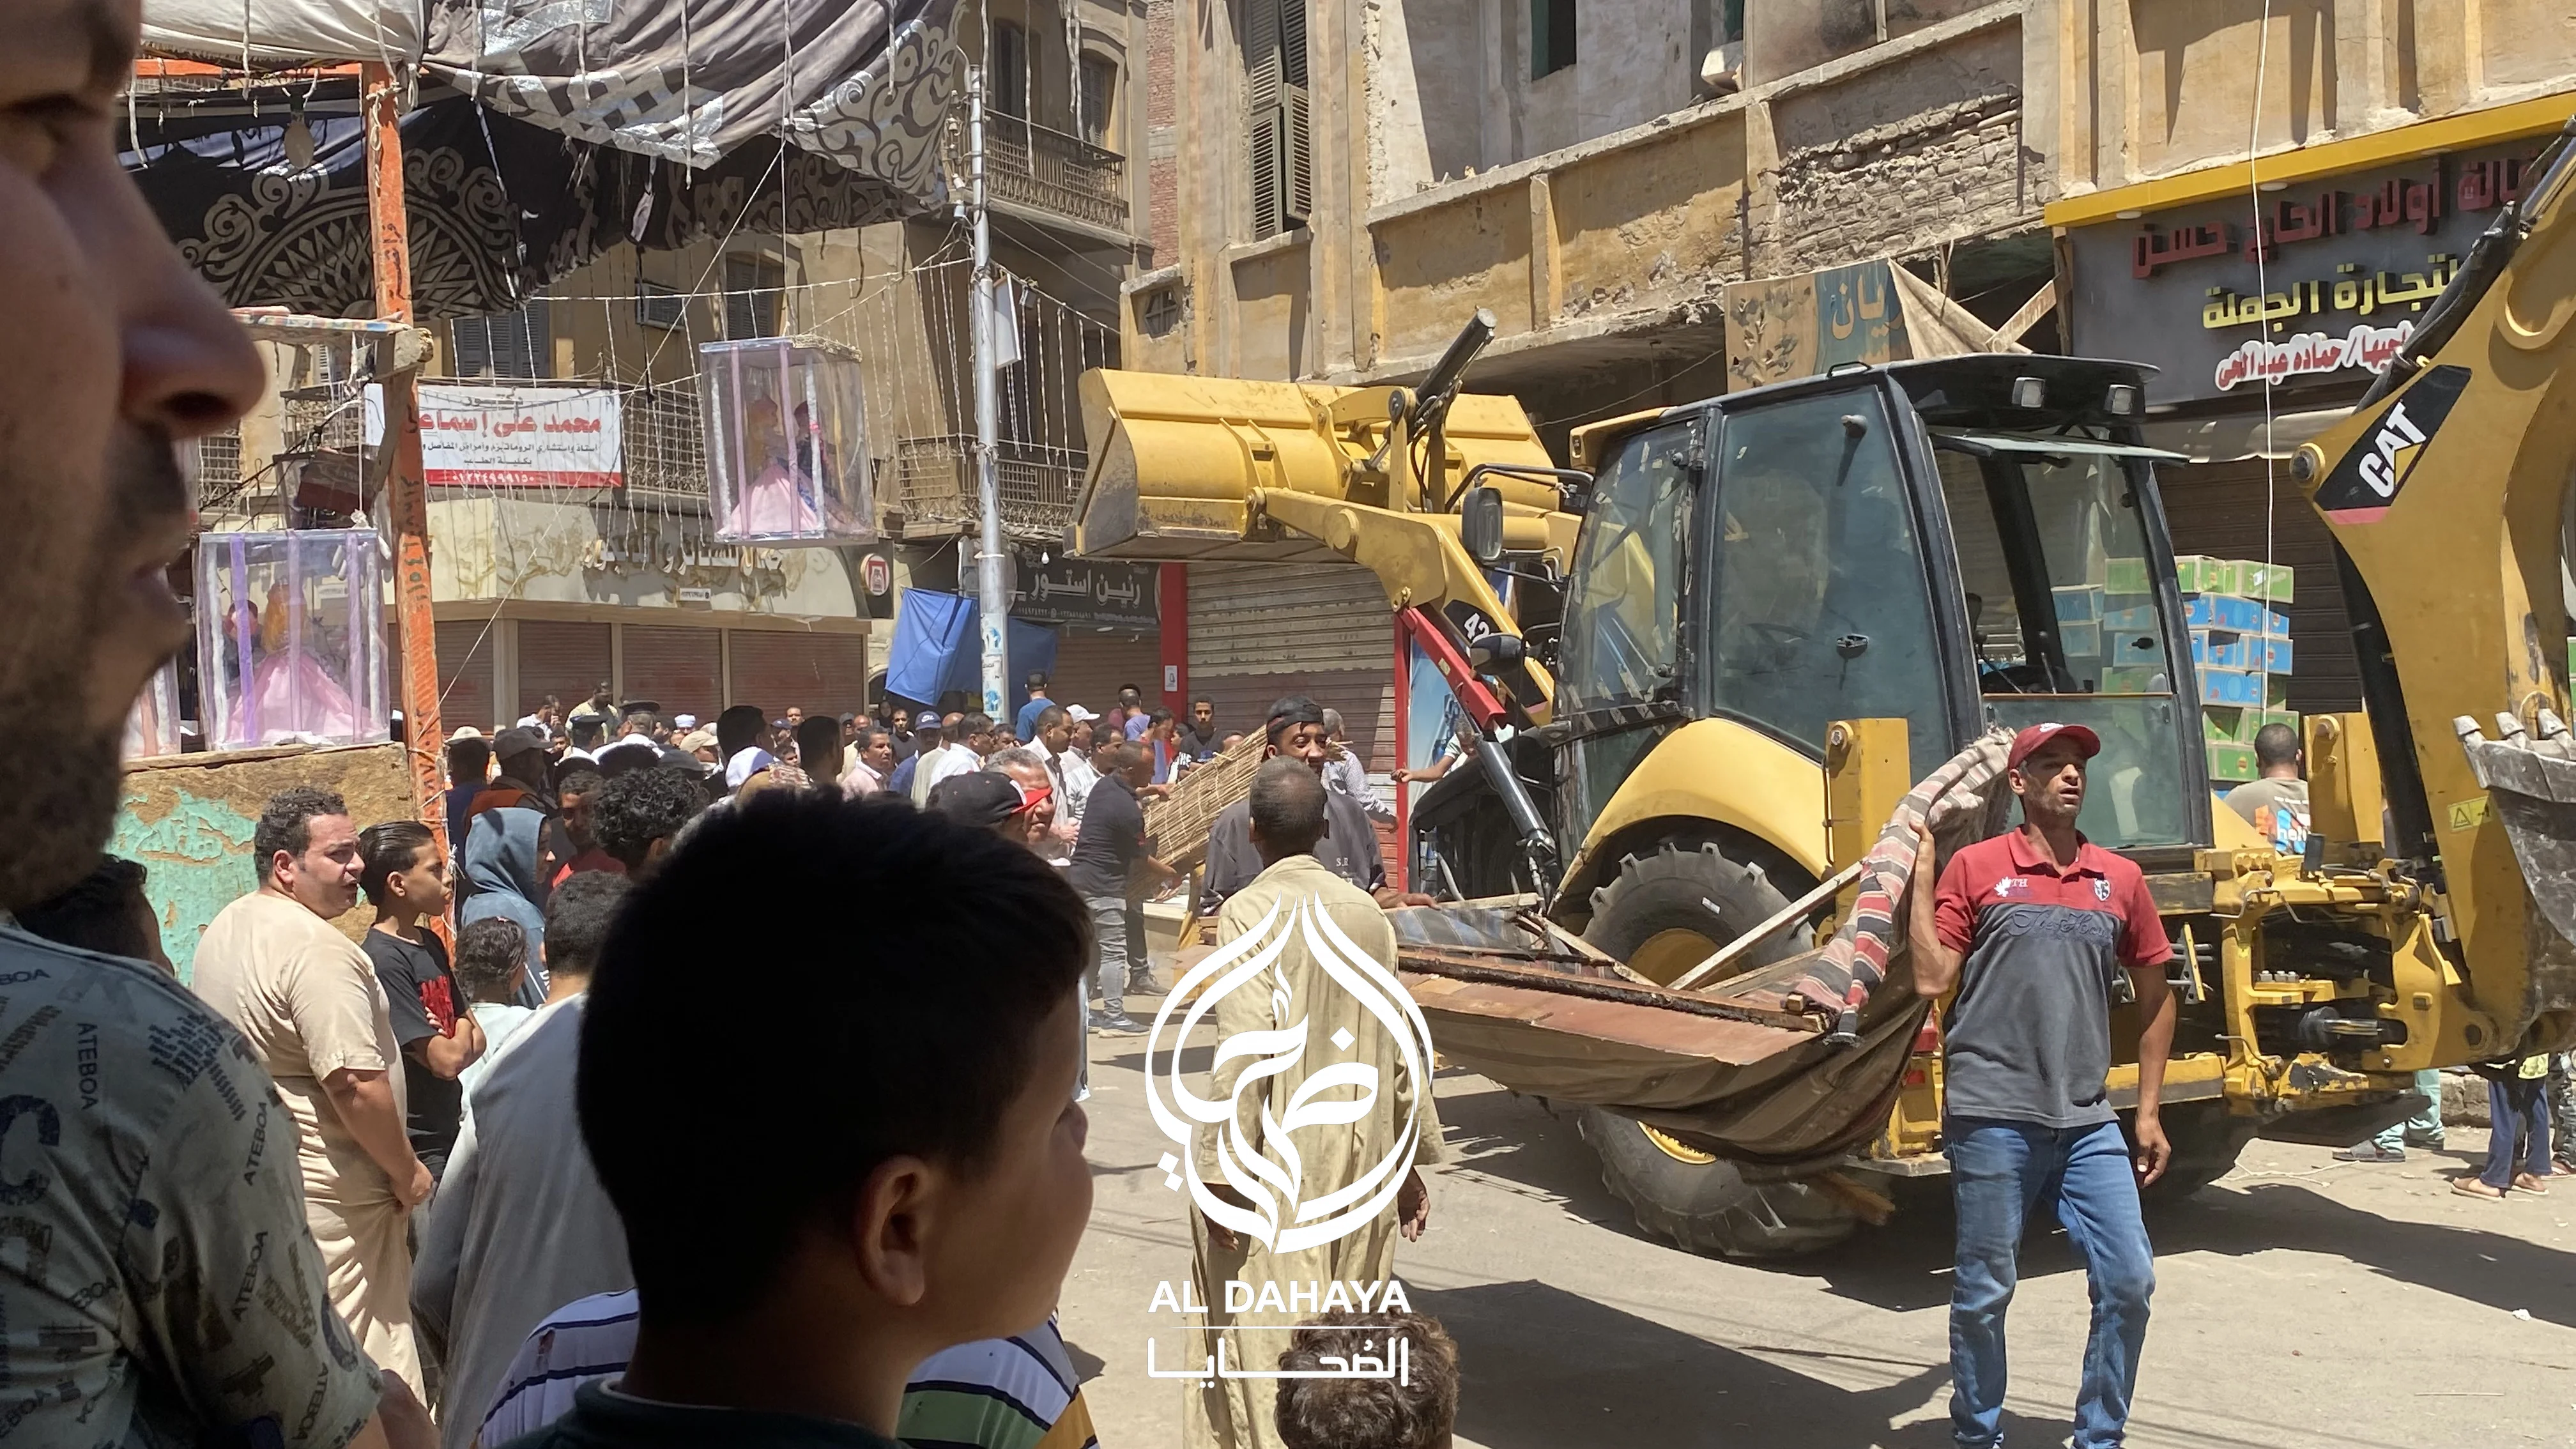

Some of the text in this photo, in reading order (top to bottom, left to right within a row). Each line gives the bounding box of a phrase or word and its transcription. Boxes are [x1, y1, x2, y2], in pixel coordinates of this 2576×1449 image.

[2244, 194, 2336, 263] الحاج
[2202, 279, 2320, 333] الجملة
[543, 414, 602, 434] محمد
[2359, 401, 2426, 498] CAT
[1030, 568, 1141, 608] رنين استور
[0, 969, 51, 986] BOA
[77, 1022, 99, 1110] ATEBOA
[243, 1101, 268, 1186] ATEBOA
[231, 1230, 269, 1322] ATEBOA
